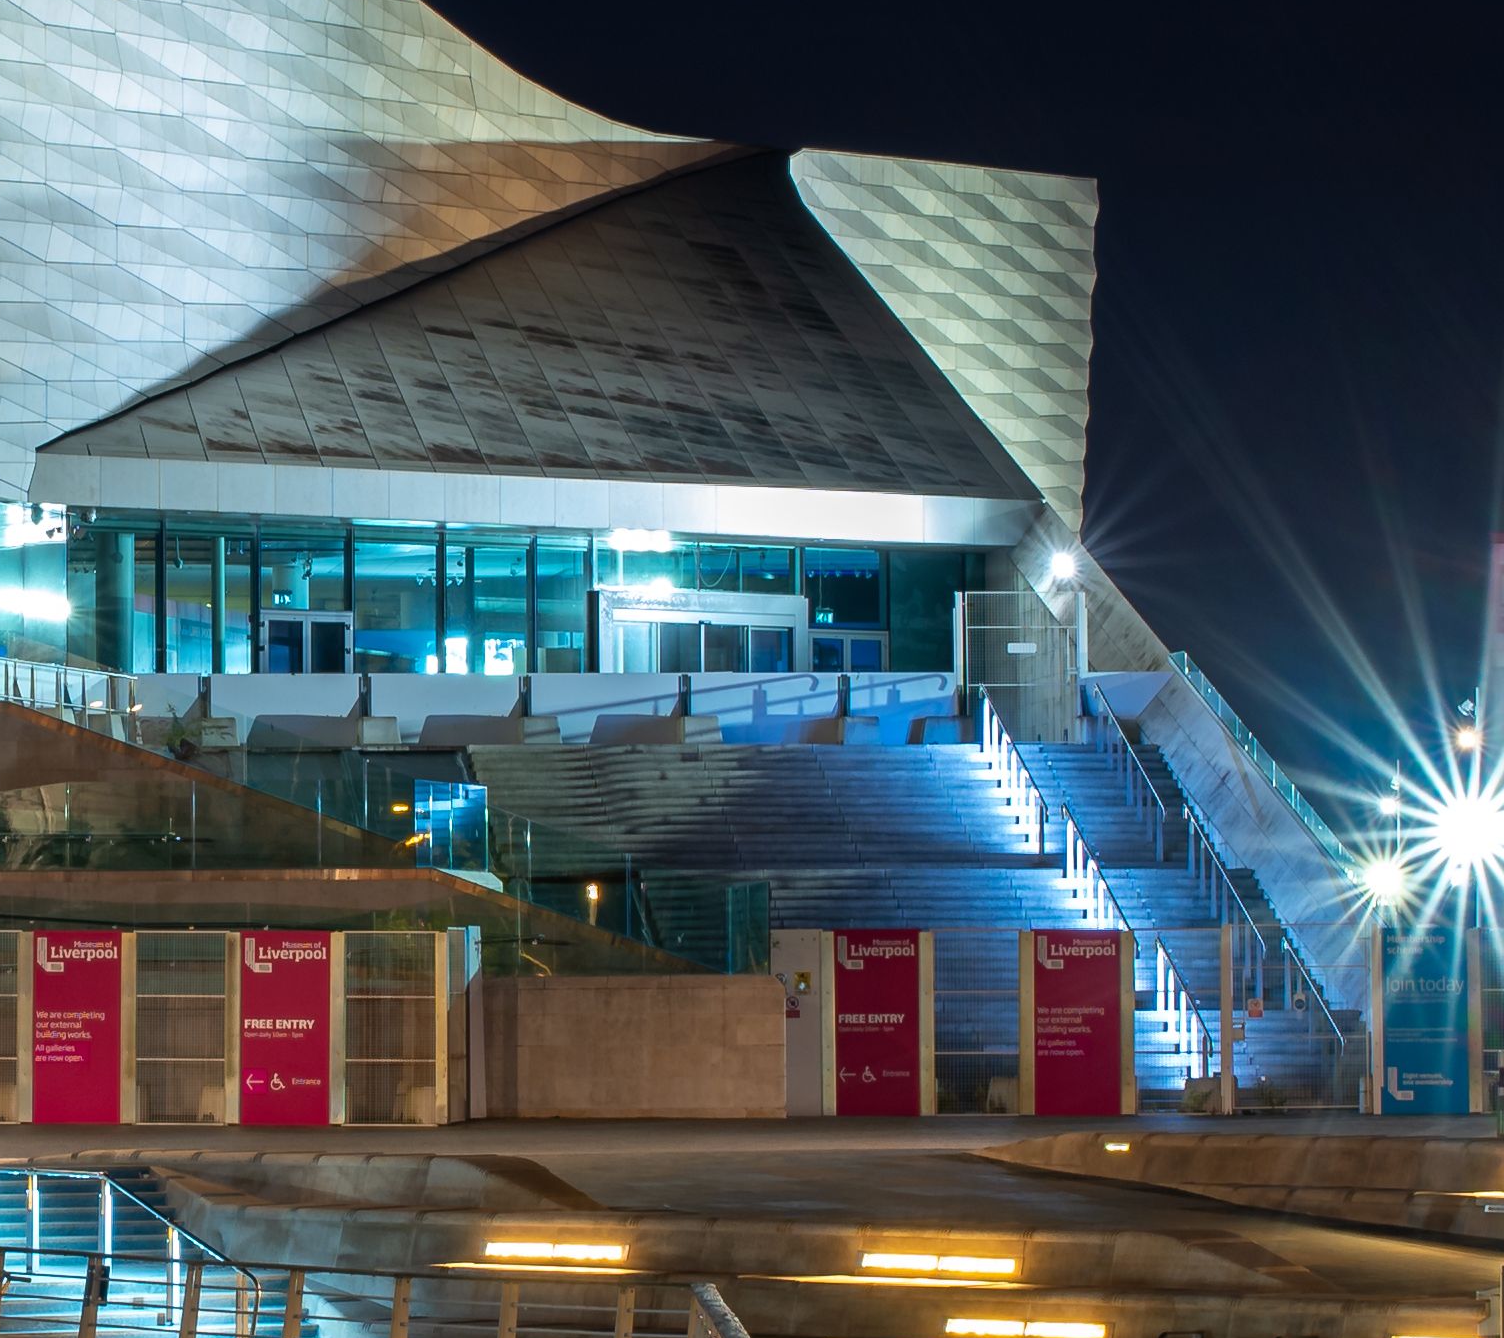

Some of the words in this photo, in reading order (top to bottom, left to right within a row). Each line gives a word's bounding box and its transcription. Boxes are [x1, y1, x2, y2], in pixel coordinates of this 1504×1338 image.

[73, 940, 104, 948] Museum
[104, 940, 113, 948] of
[282, 941, 313, 949] Museum
[313, 941, 322, 949] of
[50, 945, 119, 961] Liverpool
[258, 946, 327, 962] Liverpool
[850, 944, 915, 959] Liverpool
[1050, 943, 1116, 959] Liverpool
[1419, 975, 1464, 996] today
[62, 1011, 105, 1021] completing
[837, 1013, 866, 1024] FREE
[868, 1013, 905, 1024] ENTRY
[244, 1018, 273, 1029] FREE
[276, 1018, 315, 1029] ENTRY
[35, 1030, 66, 1040] building
[45, 1044, 75, 1053] galleries
[291, 1077, 321, 1085] Entrance
